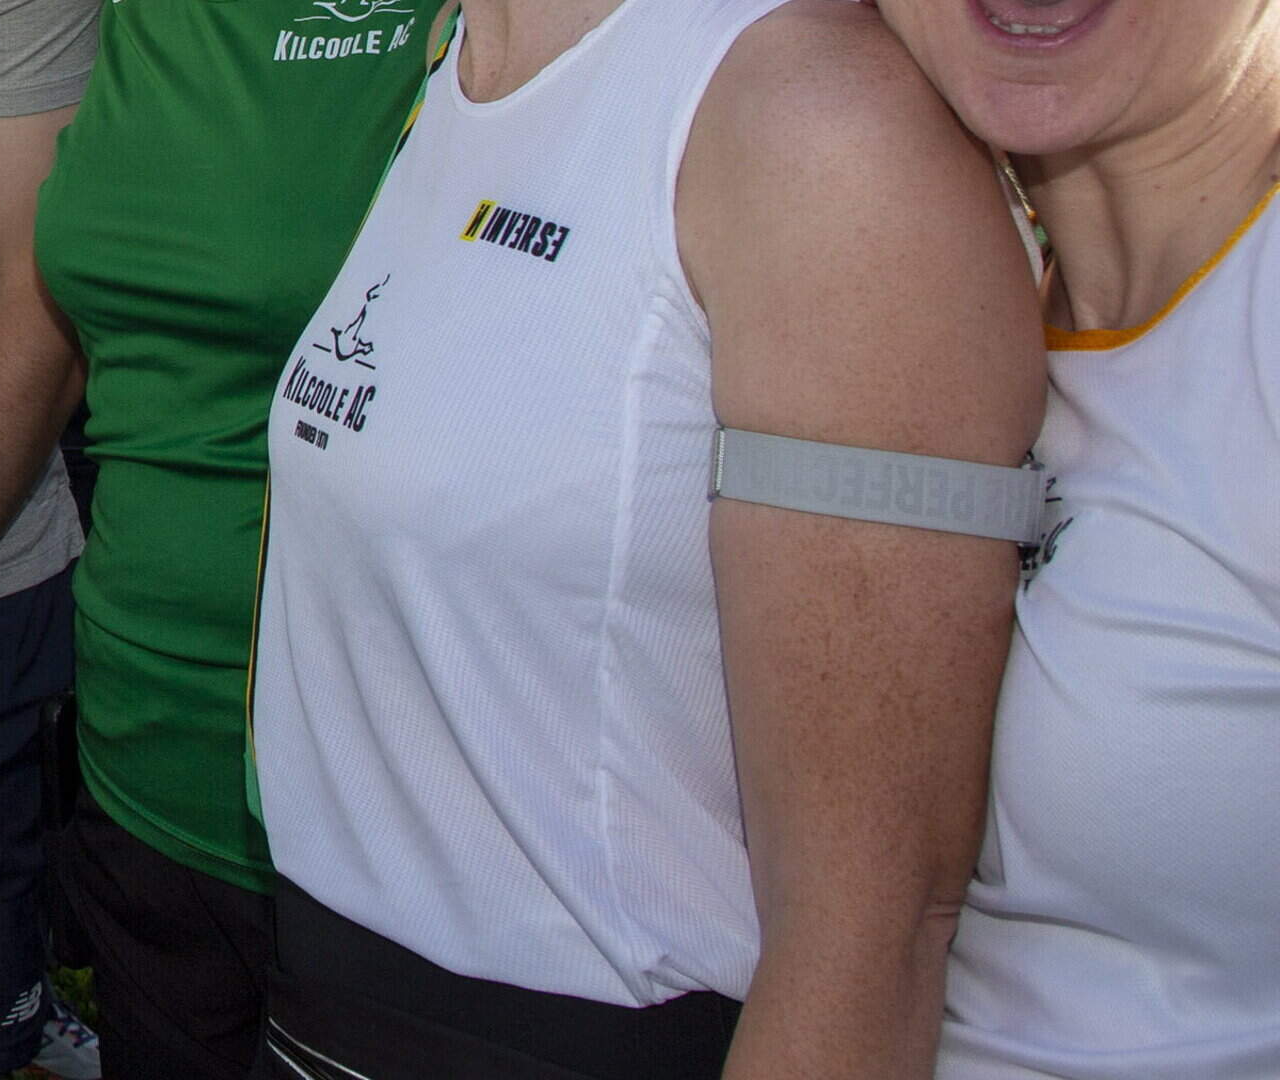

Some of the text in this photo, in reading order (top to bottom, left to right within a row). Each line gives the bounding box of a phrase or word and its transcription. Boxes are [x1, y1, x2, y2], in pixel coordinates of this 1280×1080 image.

[273, 16, 416, 61] KILCOOLE AC
[282, 355, 377, 433] KILCOOLE AC
